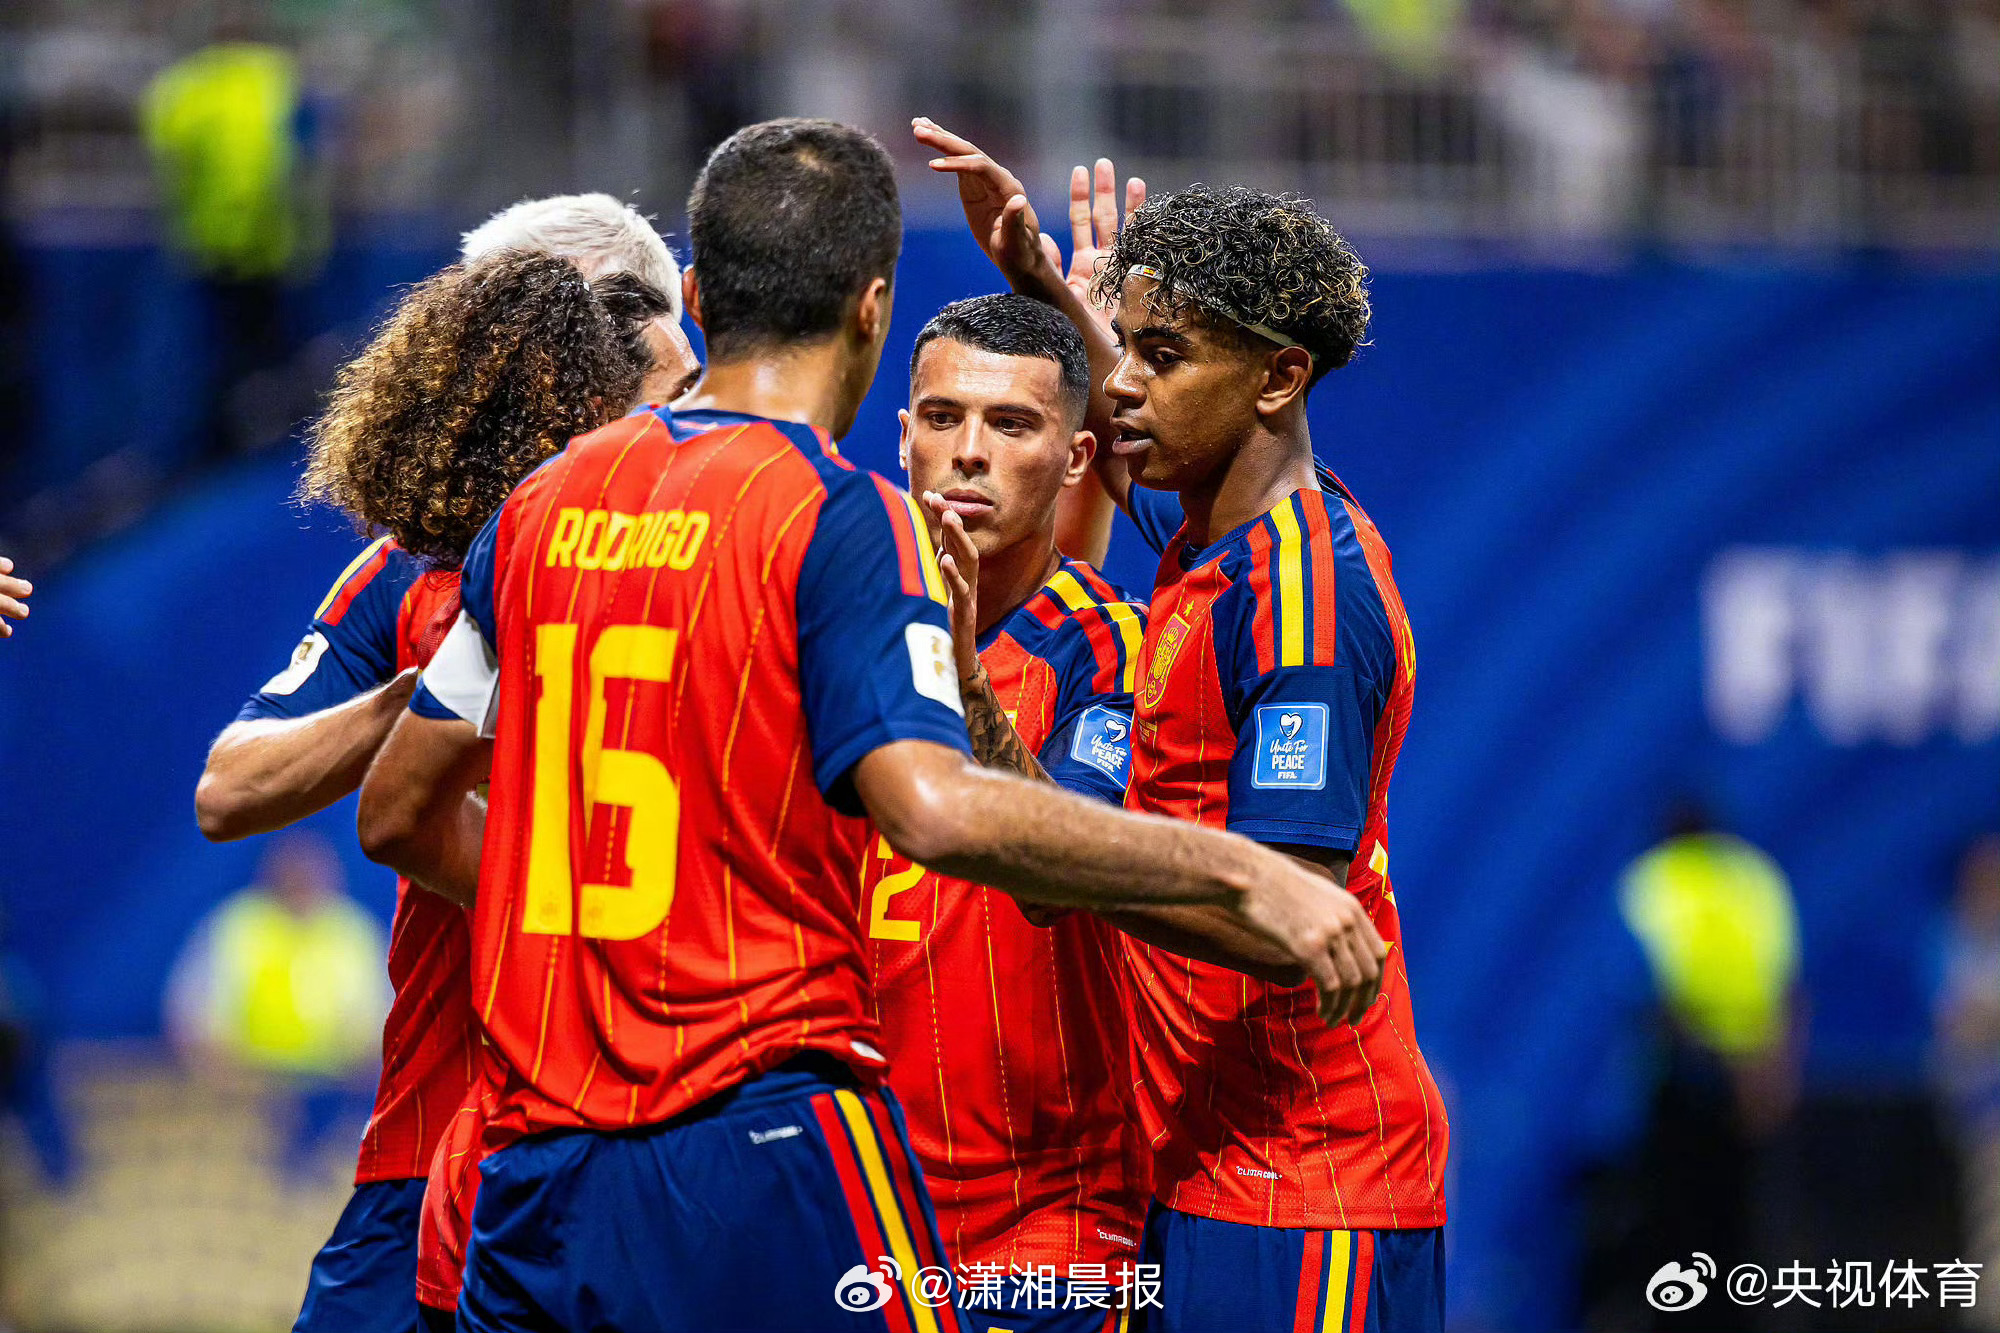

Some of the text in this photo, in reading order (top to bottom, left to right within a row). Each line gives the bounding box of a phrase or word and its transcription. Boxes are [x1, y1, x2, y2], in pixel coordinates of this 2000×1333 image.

[545, 507, 710, 572] RODRIGO
[1270, 739, 1309, 754] Unite For
[1091, 746, 1125, 770] PEACE
[1271, 755, 1306, 770] PEACE
[522, 622, 681, 941] 16
[1277, 771, 1298, 780] FIFA
